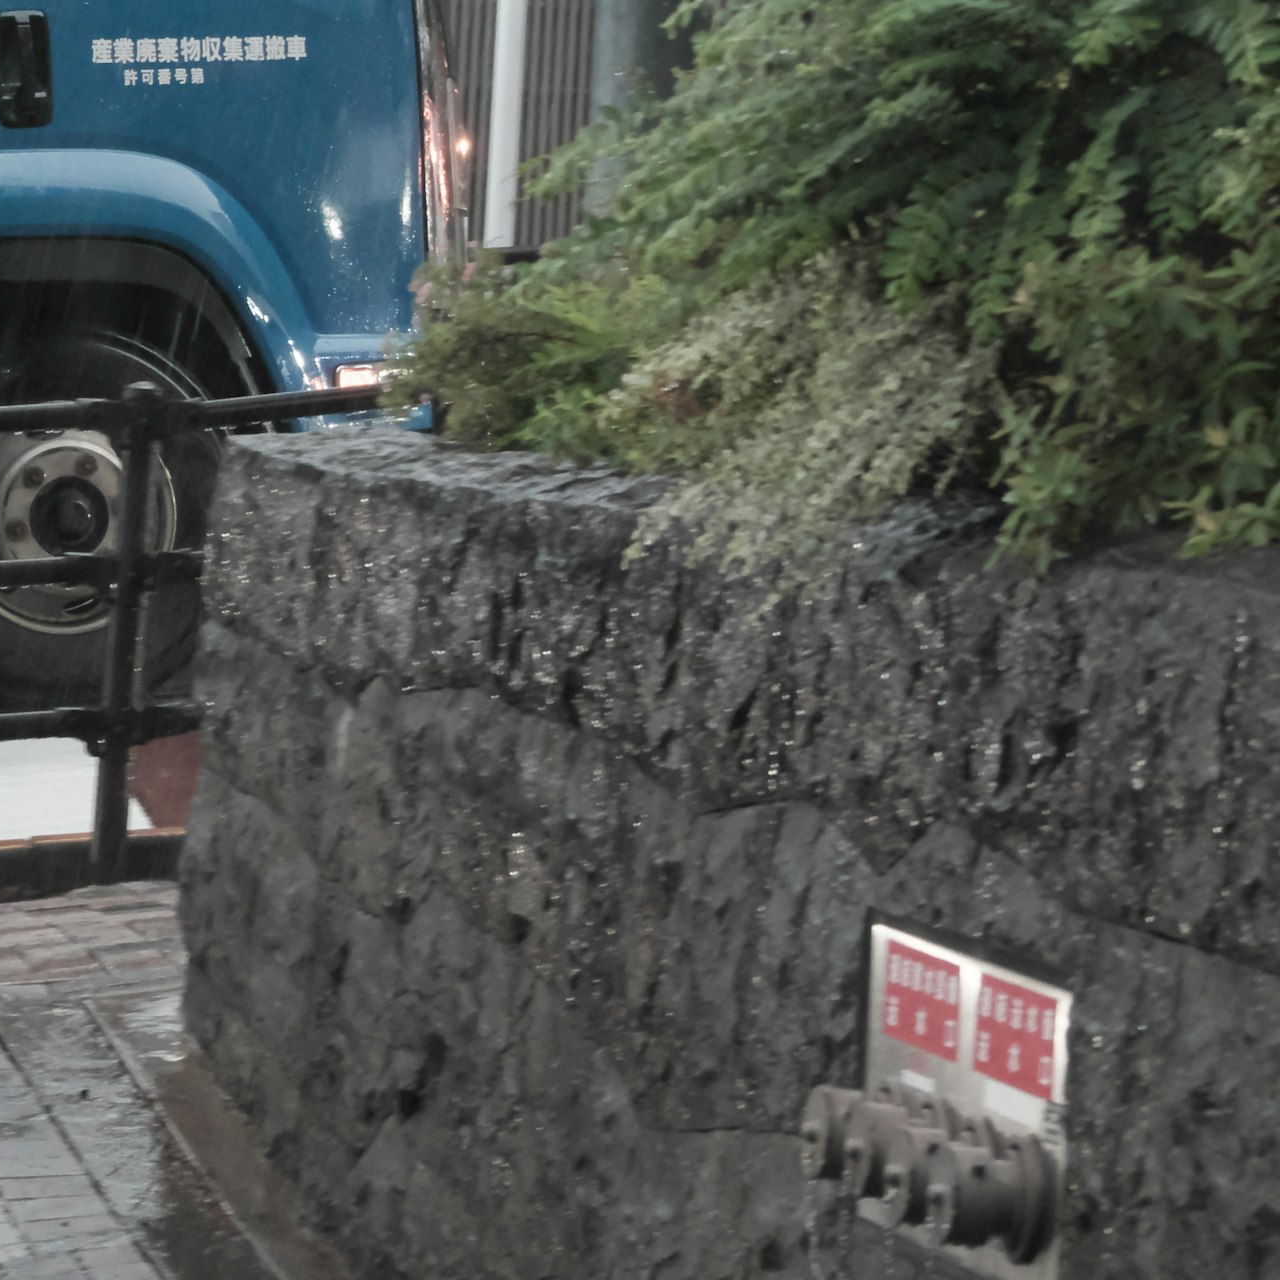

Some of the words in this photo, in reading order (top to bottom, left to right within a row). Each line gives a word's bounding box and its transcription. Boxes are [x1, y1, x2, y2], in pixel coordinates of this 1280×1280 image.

[91, 34, 308, 64] 産業廃棄物収集運搬車
[123, 68, 205, 87] 許可番号第
